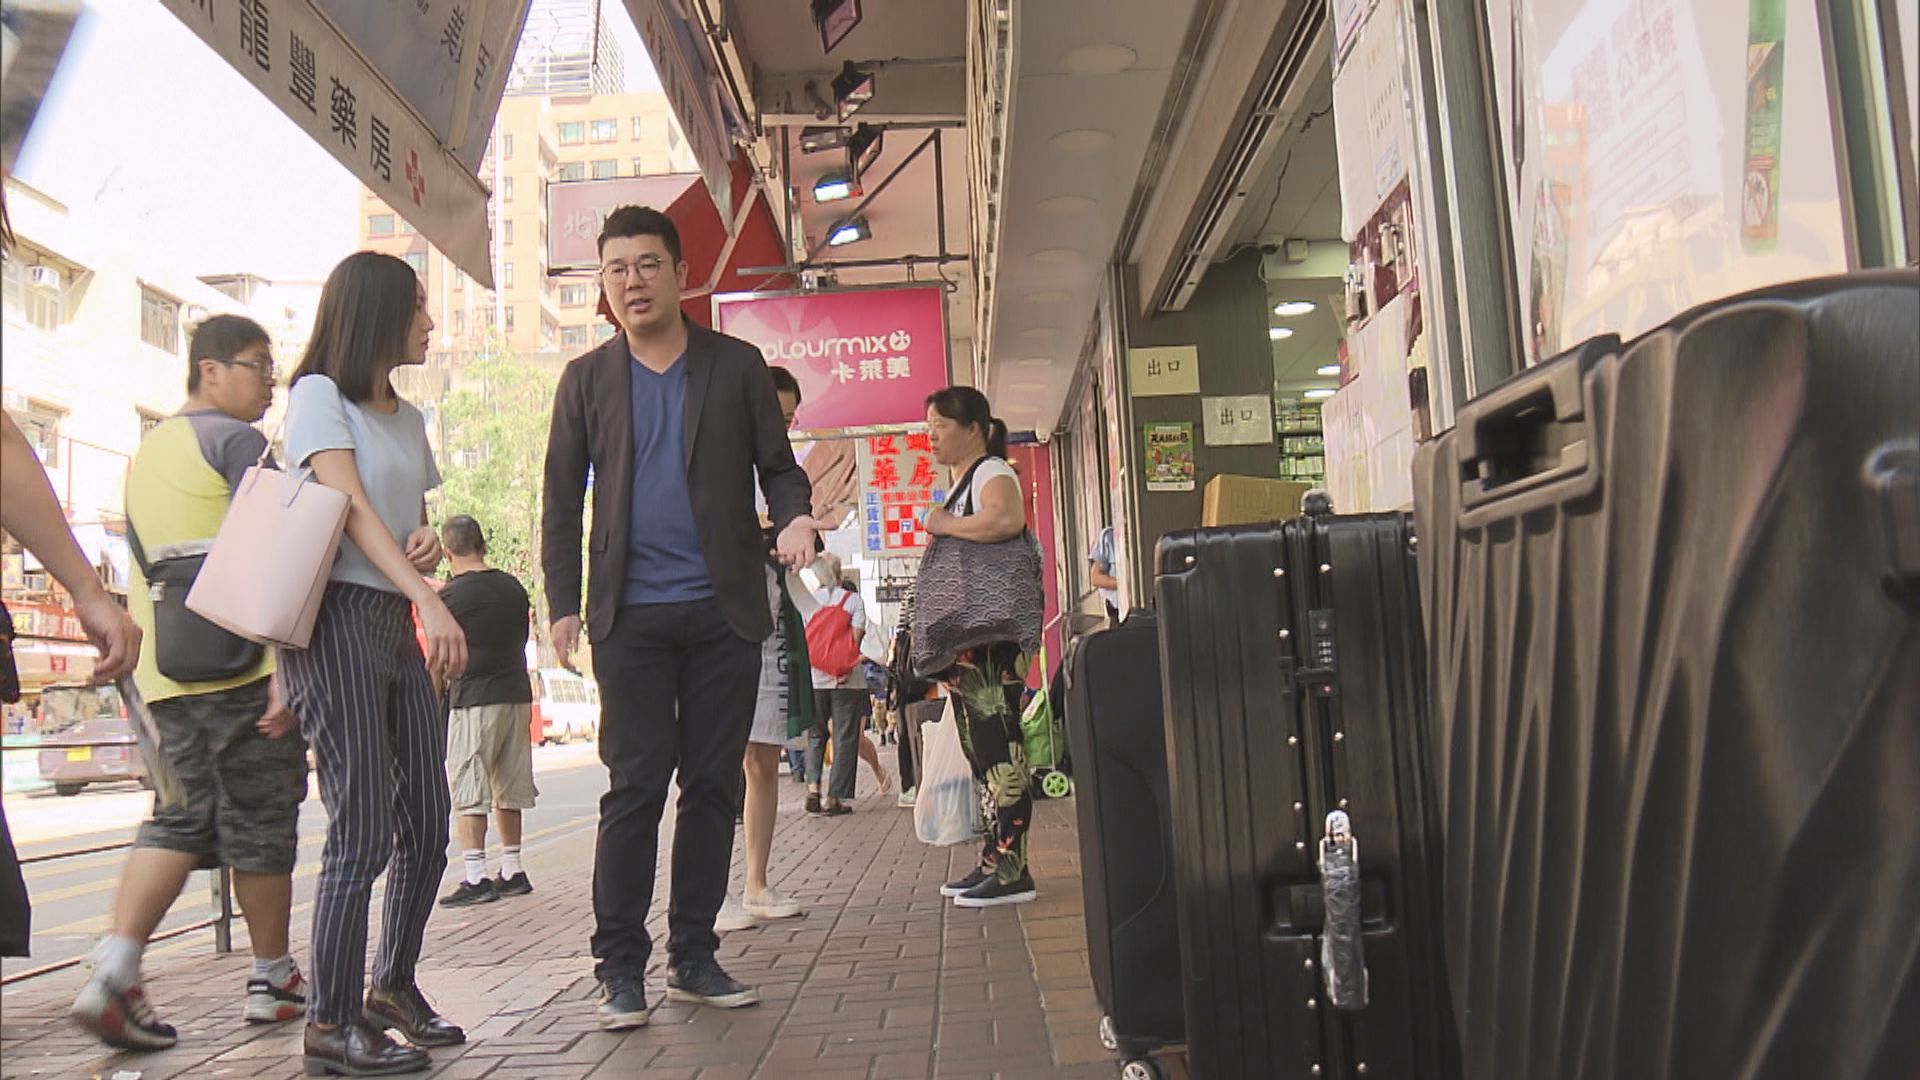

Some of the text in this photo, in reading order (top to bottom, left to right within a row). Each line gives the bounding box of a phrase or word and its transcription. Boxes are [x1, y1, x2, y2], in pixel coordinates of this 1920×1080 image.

[830, 356, 910, 383] 卡萊美
[1148, 358, 1181, 376] 出口
[1220, 408, 1253, 426] 出口
[867, 455, 938, 490] 藥房
